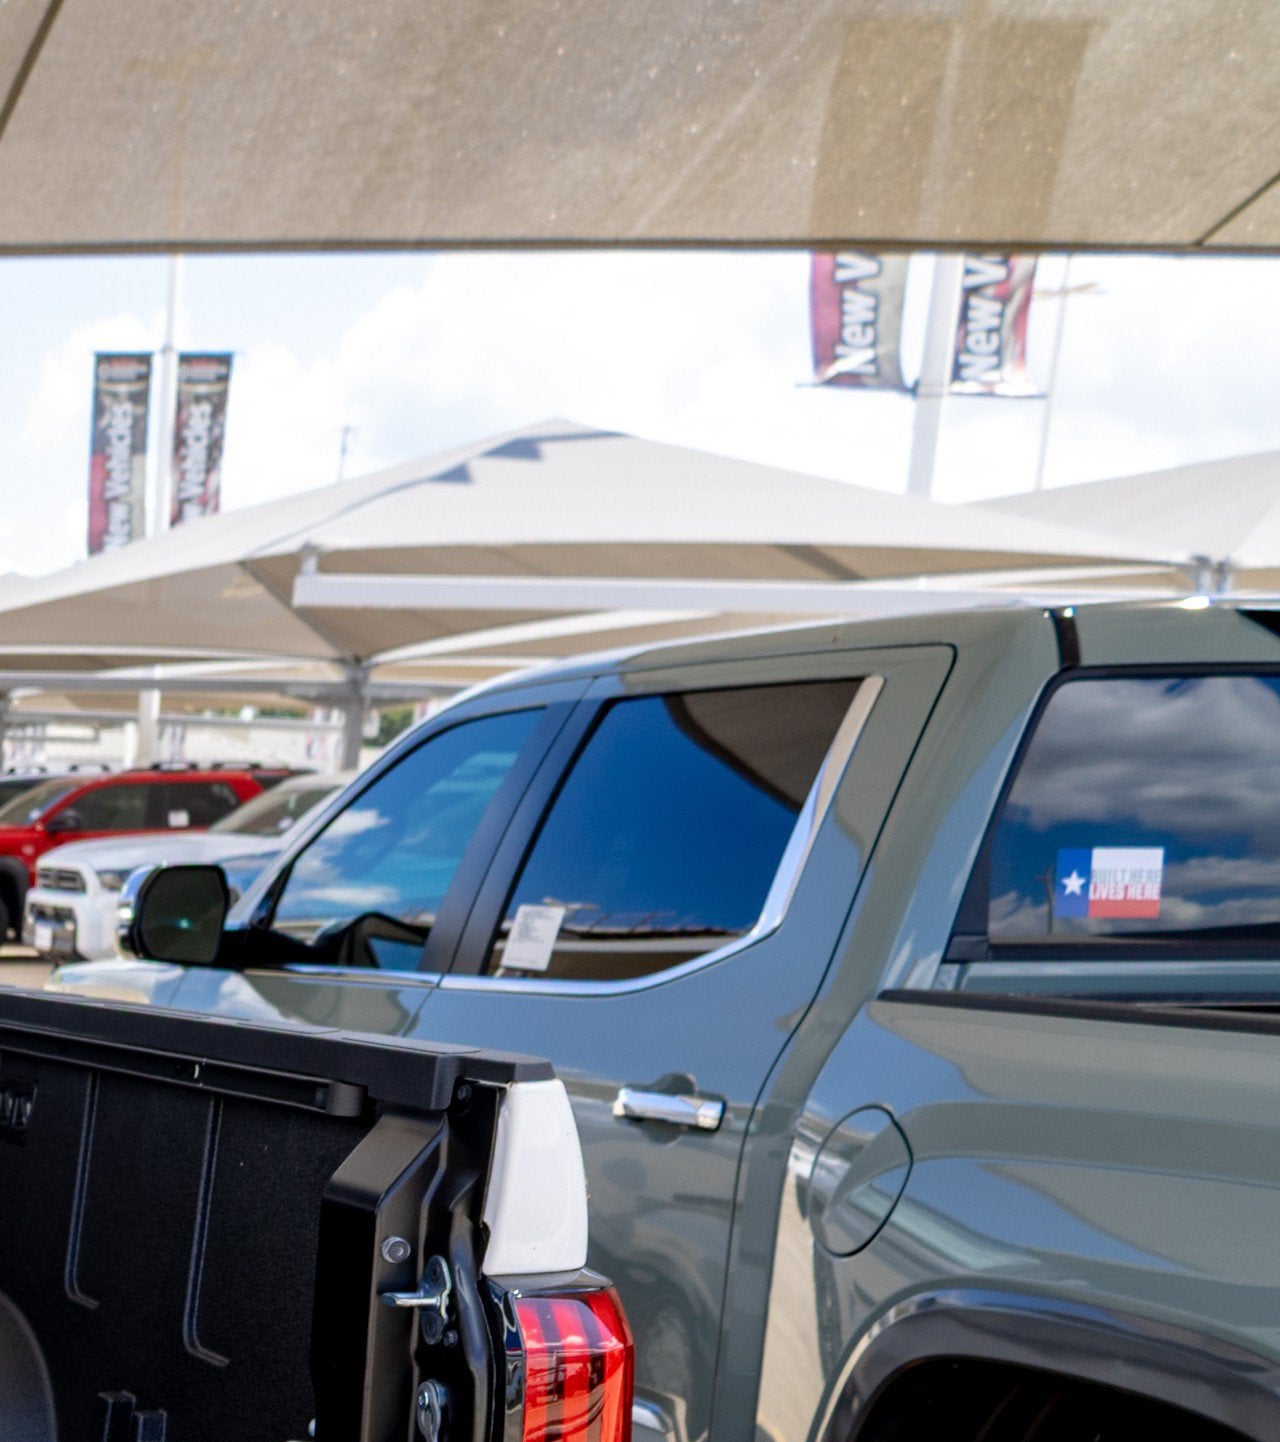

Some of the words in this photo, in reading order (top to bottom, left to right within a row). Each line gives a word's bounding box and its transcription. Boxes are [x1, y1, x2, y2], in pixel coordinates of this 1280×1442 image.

[835, 288, 877, 375] New
[957, 294, 1005, 384] New
[103, 400, 134, 500] Vehicles
[176, 400, 213, 500] Vehicles
[1089, 883, 1126, 901] LIVES
[1127, 883, 1161, 901] HERE
[1092, 868, 1127, 885] BUILT
[1129, 868, 1162, 885] HERE
